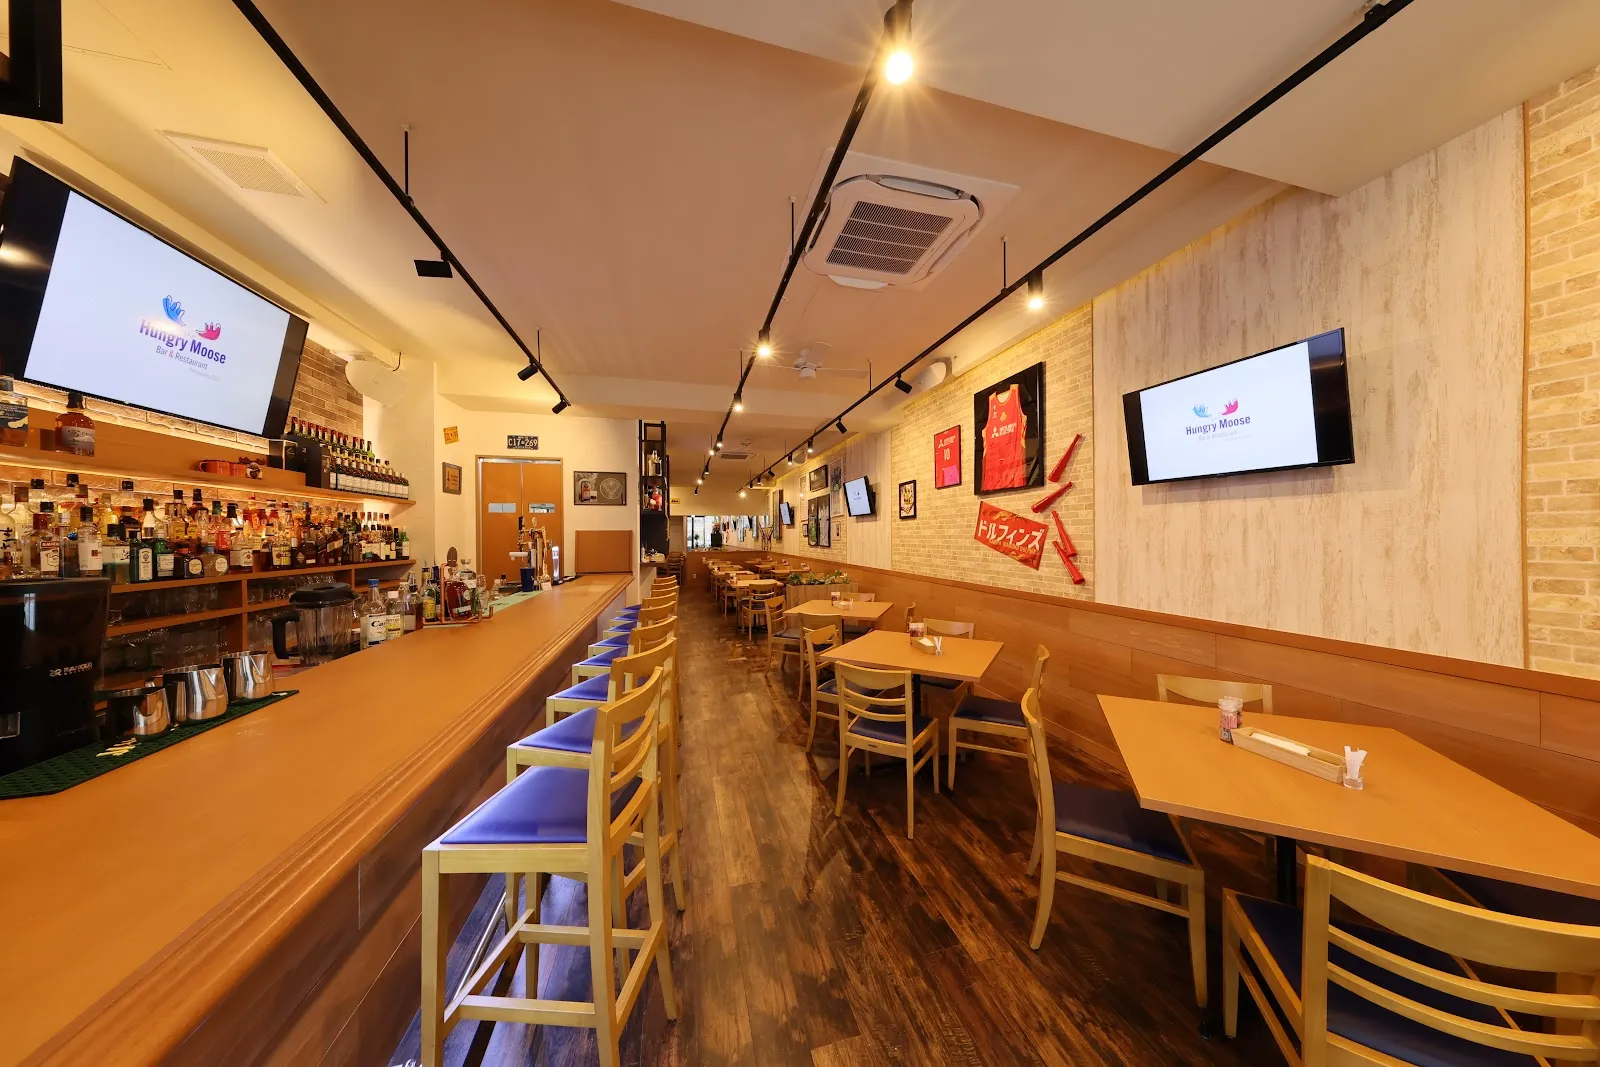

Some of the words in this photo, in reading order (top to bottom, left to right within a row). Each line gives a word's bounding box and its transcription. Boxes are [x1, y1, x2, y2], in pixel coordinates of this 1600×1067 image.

[140, 319, 188, 351] Hungry
[189, 339, 226, 364] Moose
[156, 345, 168, 355] Bar
[175, 351, 208, 370] Restaurant
[1186, 423, 1217, 435] Hungry
[1219, 416, 1251, 429] Moose
[978, 519, 1045, 551] ドルフィンズ
